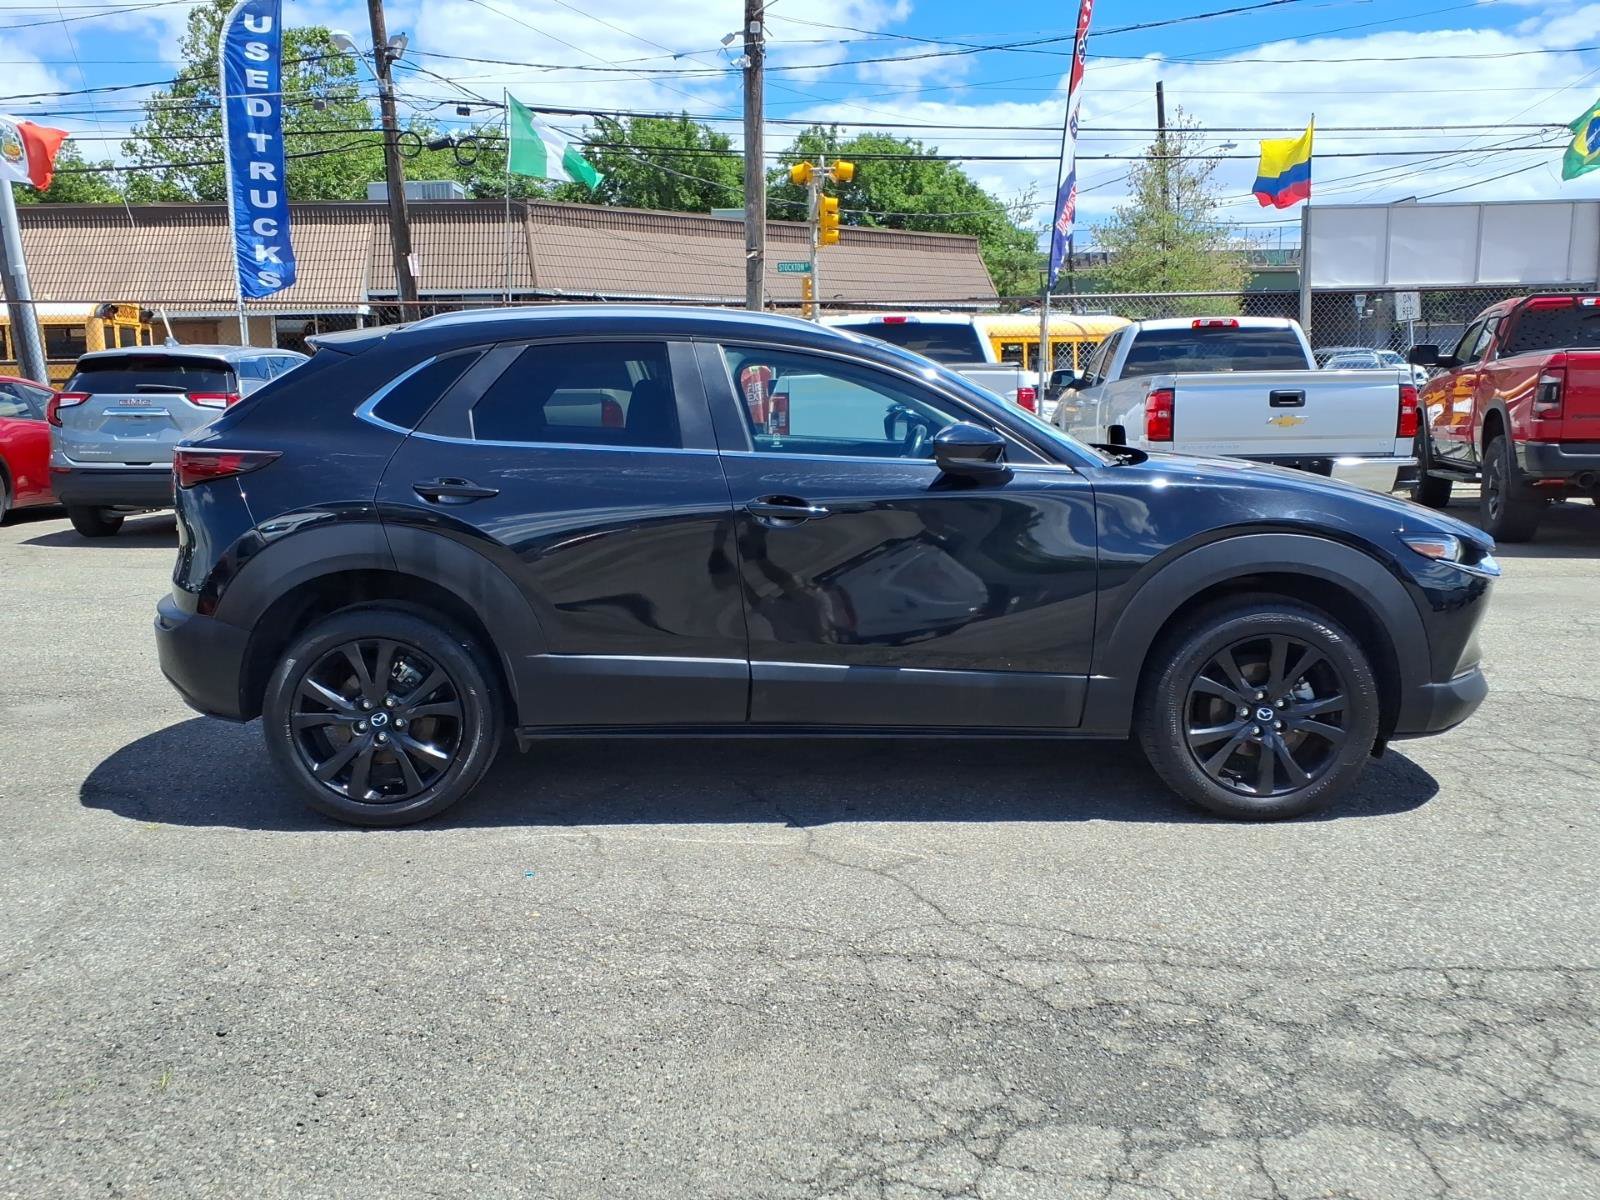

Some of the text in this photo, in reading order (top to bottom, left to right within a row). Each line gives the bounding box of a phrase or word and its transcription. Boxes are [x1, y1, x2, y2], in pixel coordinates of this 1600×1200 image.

[244, 13, 282, 288] USED TRUCKS
[778, 263, 805, 271] STOCKTON
